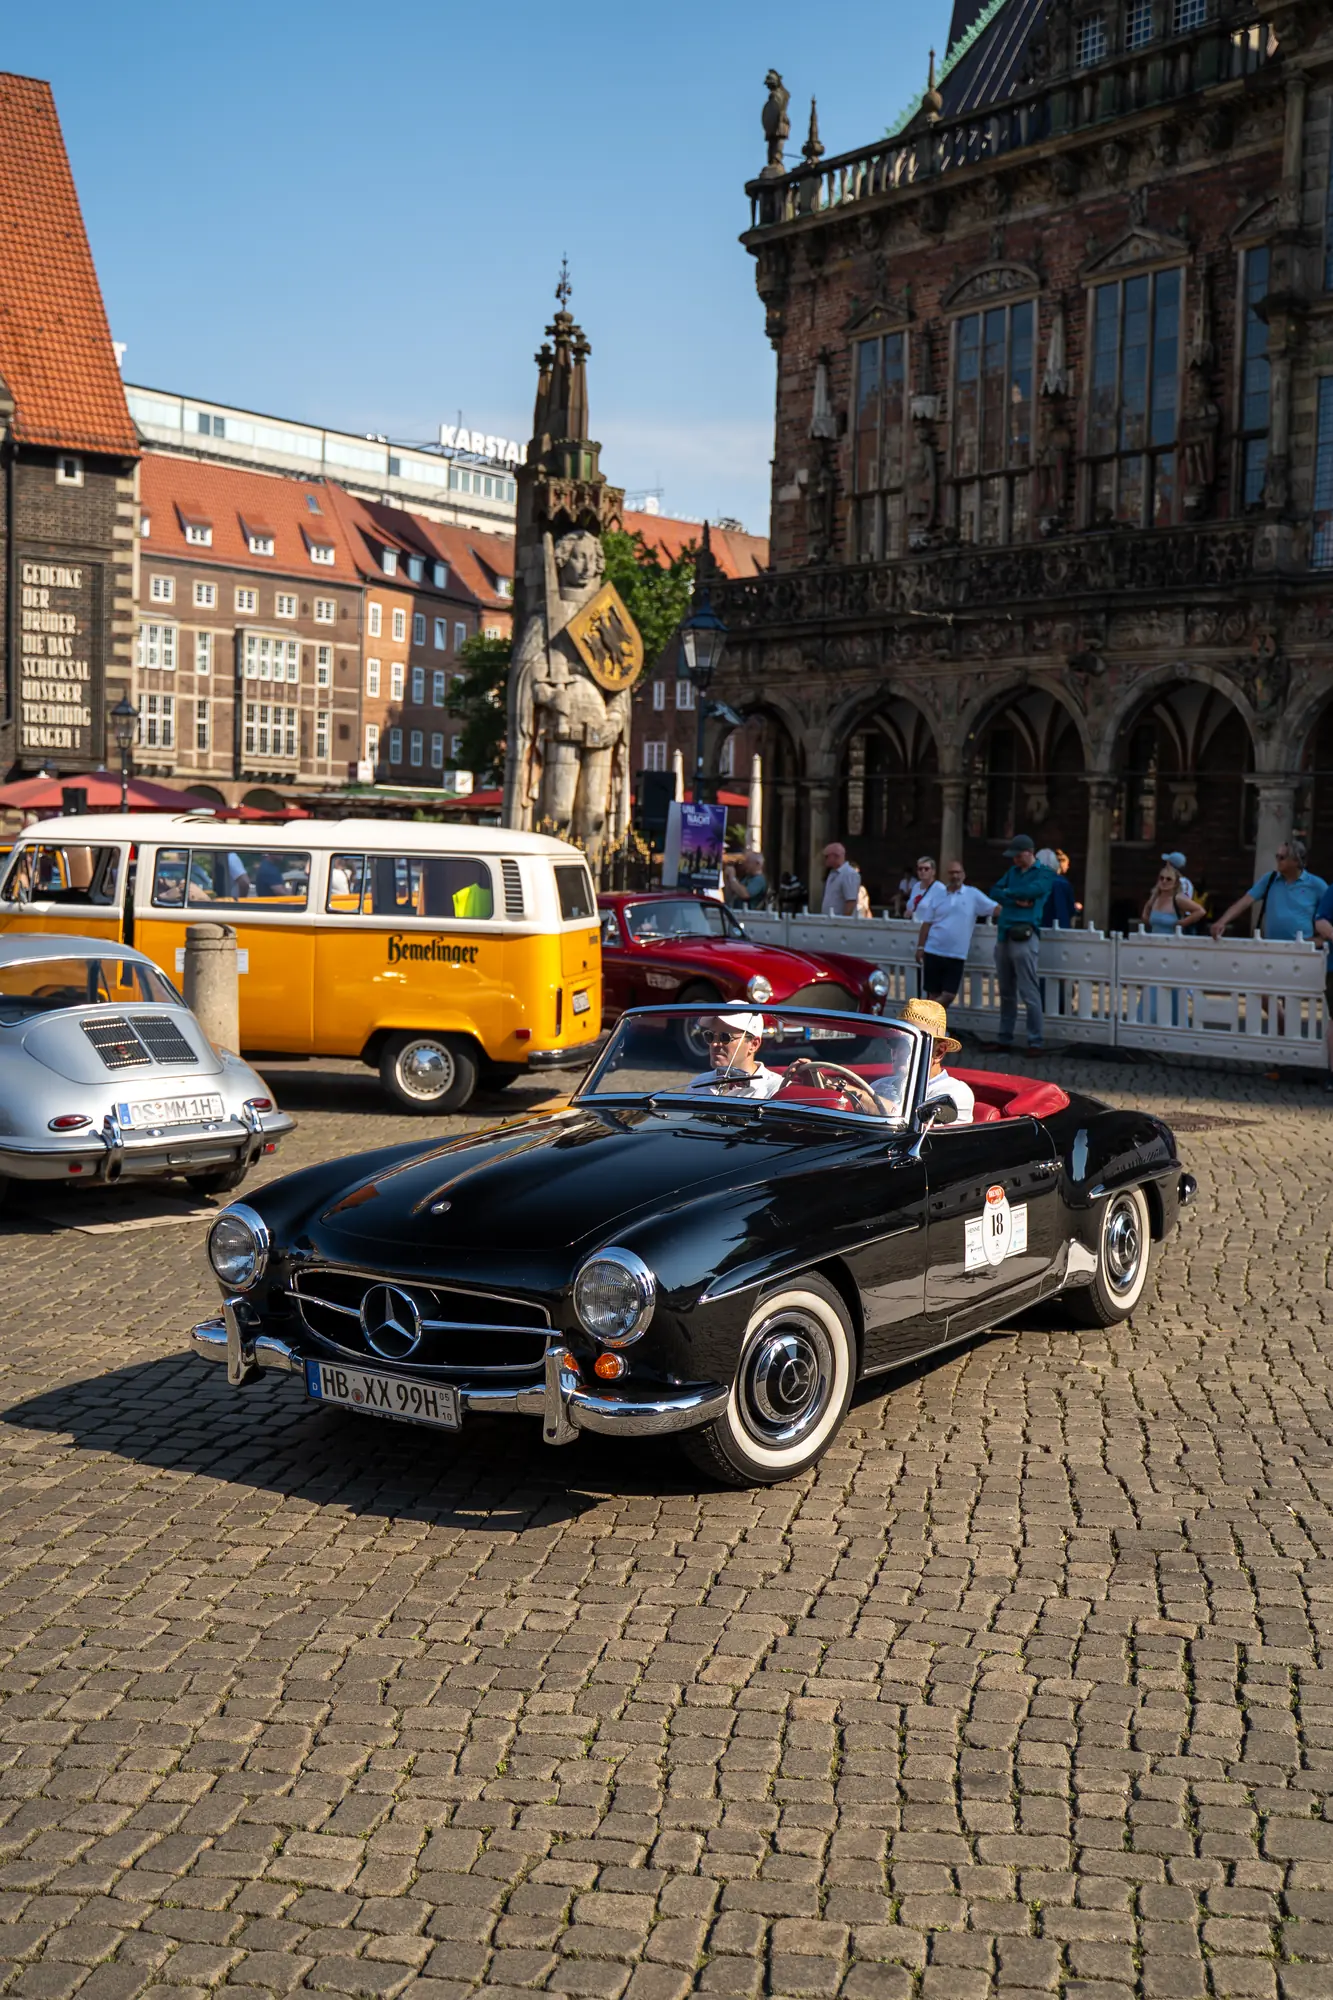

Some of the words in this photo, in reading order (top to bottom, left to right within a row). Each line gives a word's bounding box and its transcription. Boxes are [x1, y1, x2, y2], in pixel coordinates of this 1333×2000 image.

[22, 563, 82, 588] GEDENKE
[22, 587, 50, 609] DER
[22, 633, 45, 655] DIE
[47, 636, 73, 657] DAS
[21, 657, 91, 681] SCHICKSAL
[21, 680, 82, 703] UNSERER
[21, 703, 92, 727] TRENNUNG
[387, 933, 479, 965] Hemelinger
[164, 1101, 188, 1121] MM
[991, 1212, 1004, 1237] 18
[312, 1382, 318, 1391] D
[322, 1367, 349, 1399] HB
[362, 1376, 392, 1408] XX
[396, 1383, 439, 1418] 99H
[439, 1392, 450, 1402] 05
